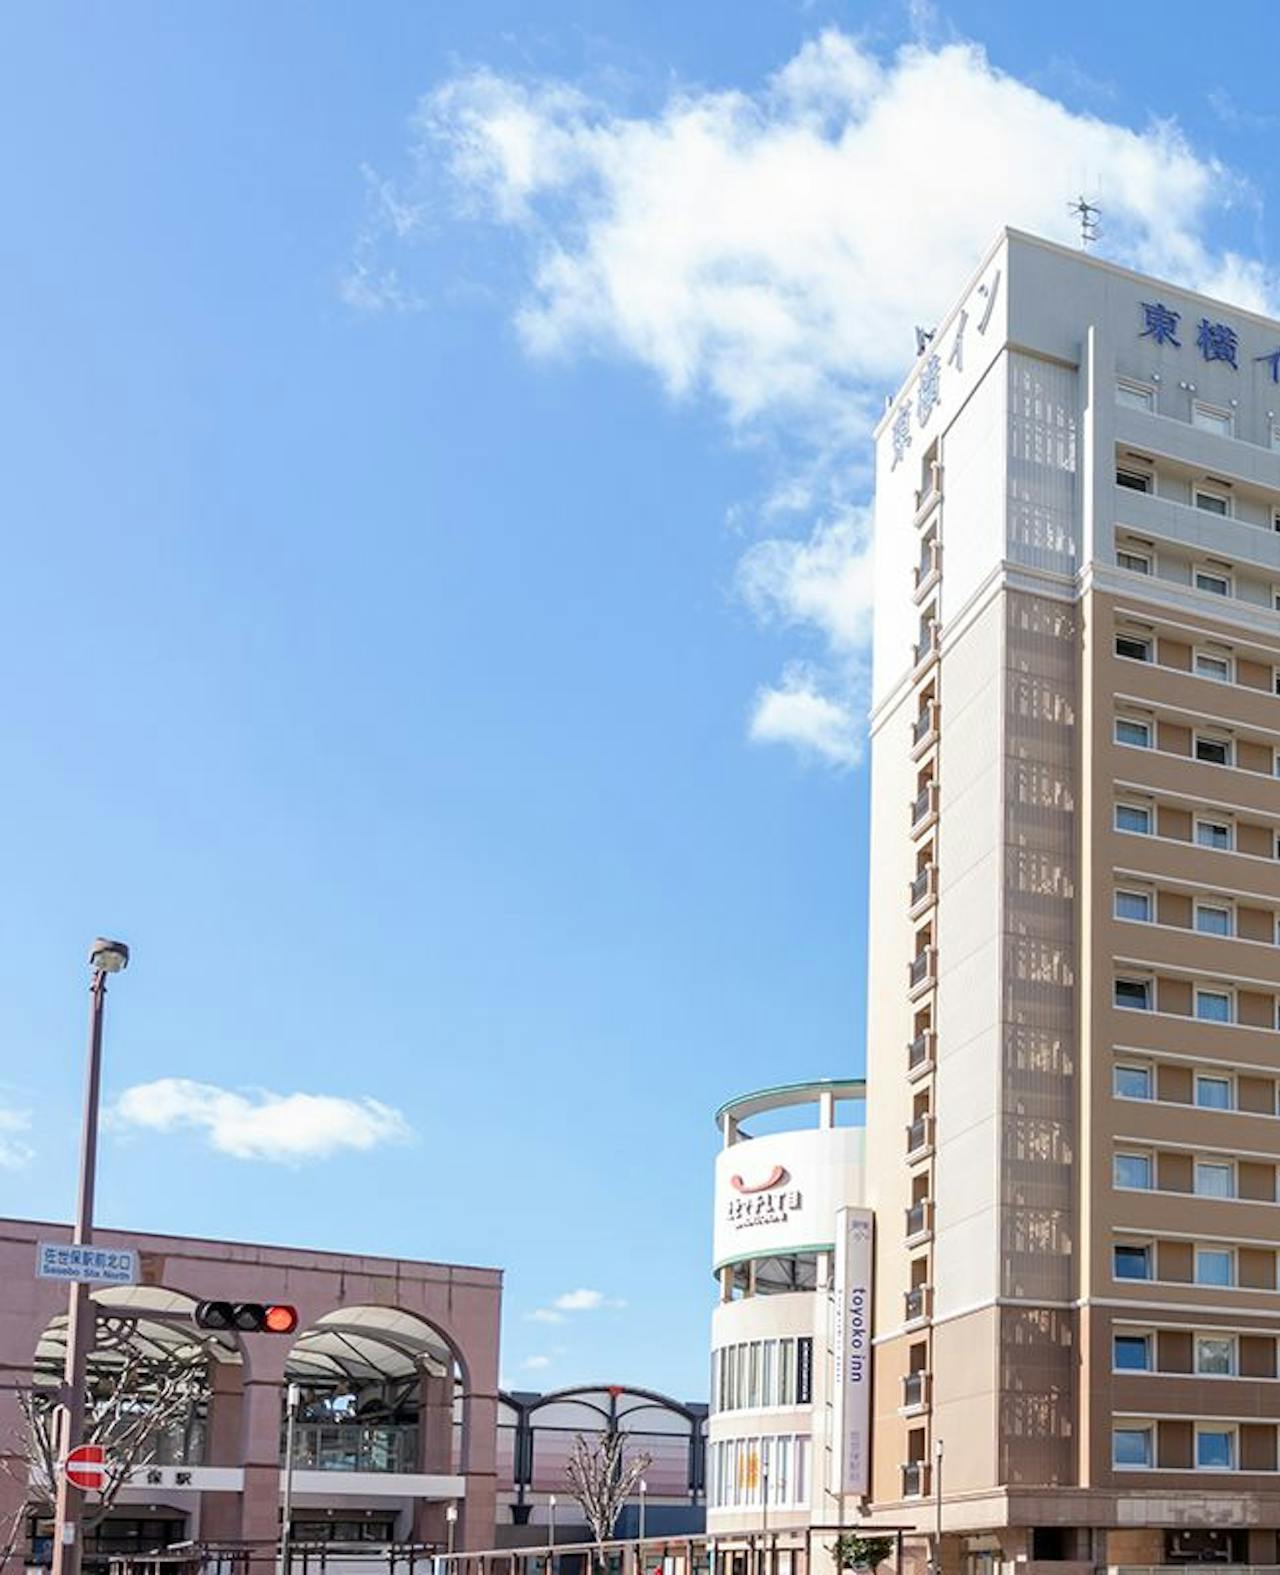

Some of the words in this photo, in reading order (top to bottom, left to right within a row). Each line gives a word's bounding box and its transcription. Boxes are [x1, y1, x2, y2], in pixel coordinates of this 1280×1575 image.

[891, 269, 1001, 473] 東横イン
[850, 1288, 866, 1349] toyoko
[851, 1354, 866, 1383] inn
